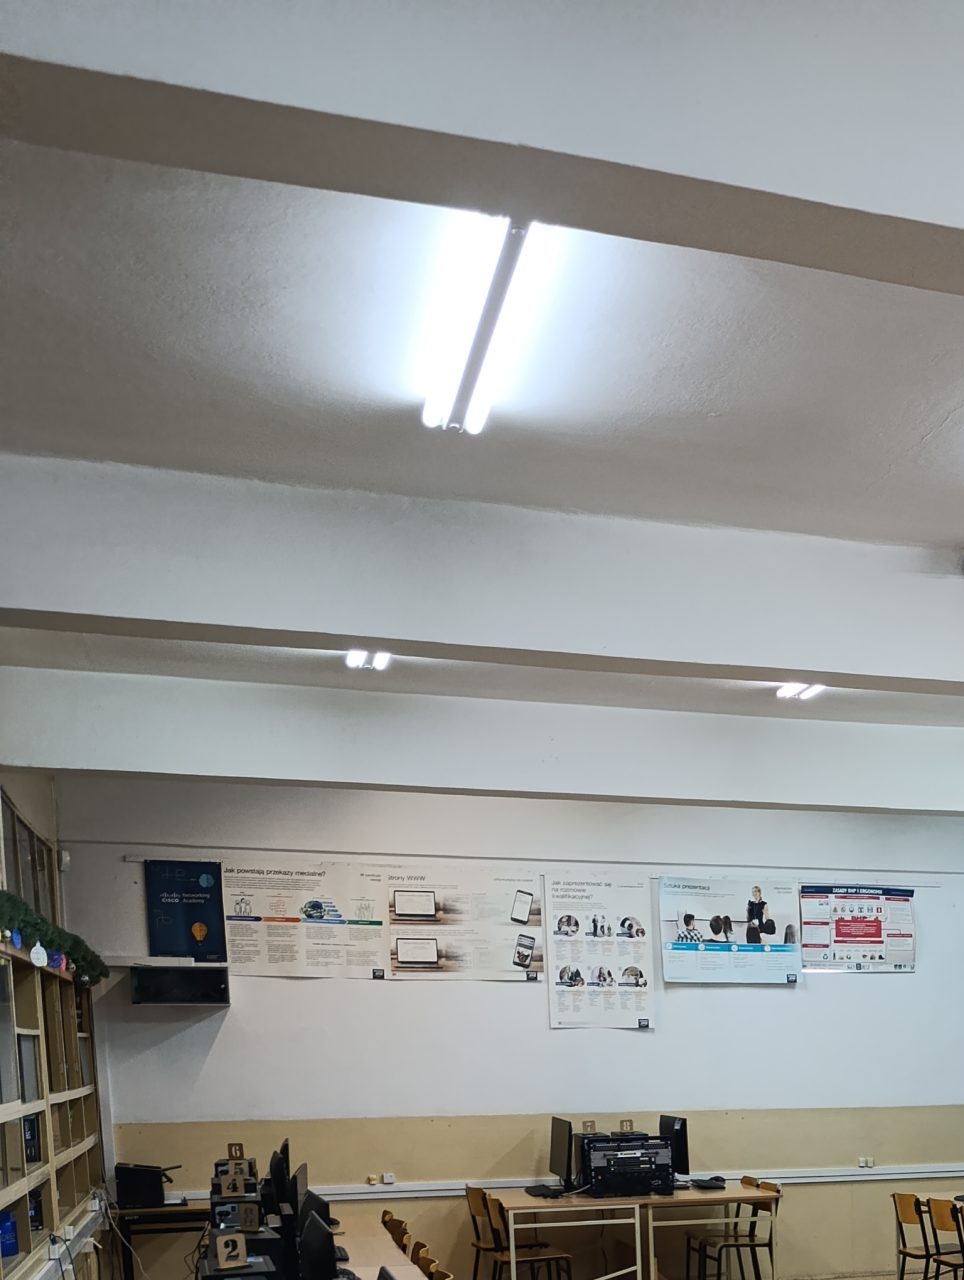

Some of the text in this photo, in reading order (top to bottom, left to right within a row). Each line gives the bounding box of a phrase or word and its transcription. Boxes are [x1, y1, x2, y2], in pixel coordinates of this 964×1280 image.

[231, 1145, 240, 1157] 6
[226, 1178, 239, 1193] 4
[223, 1238, 240, 1262] 2
